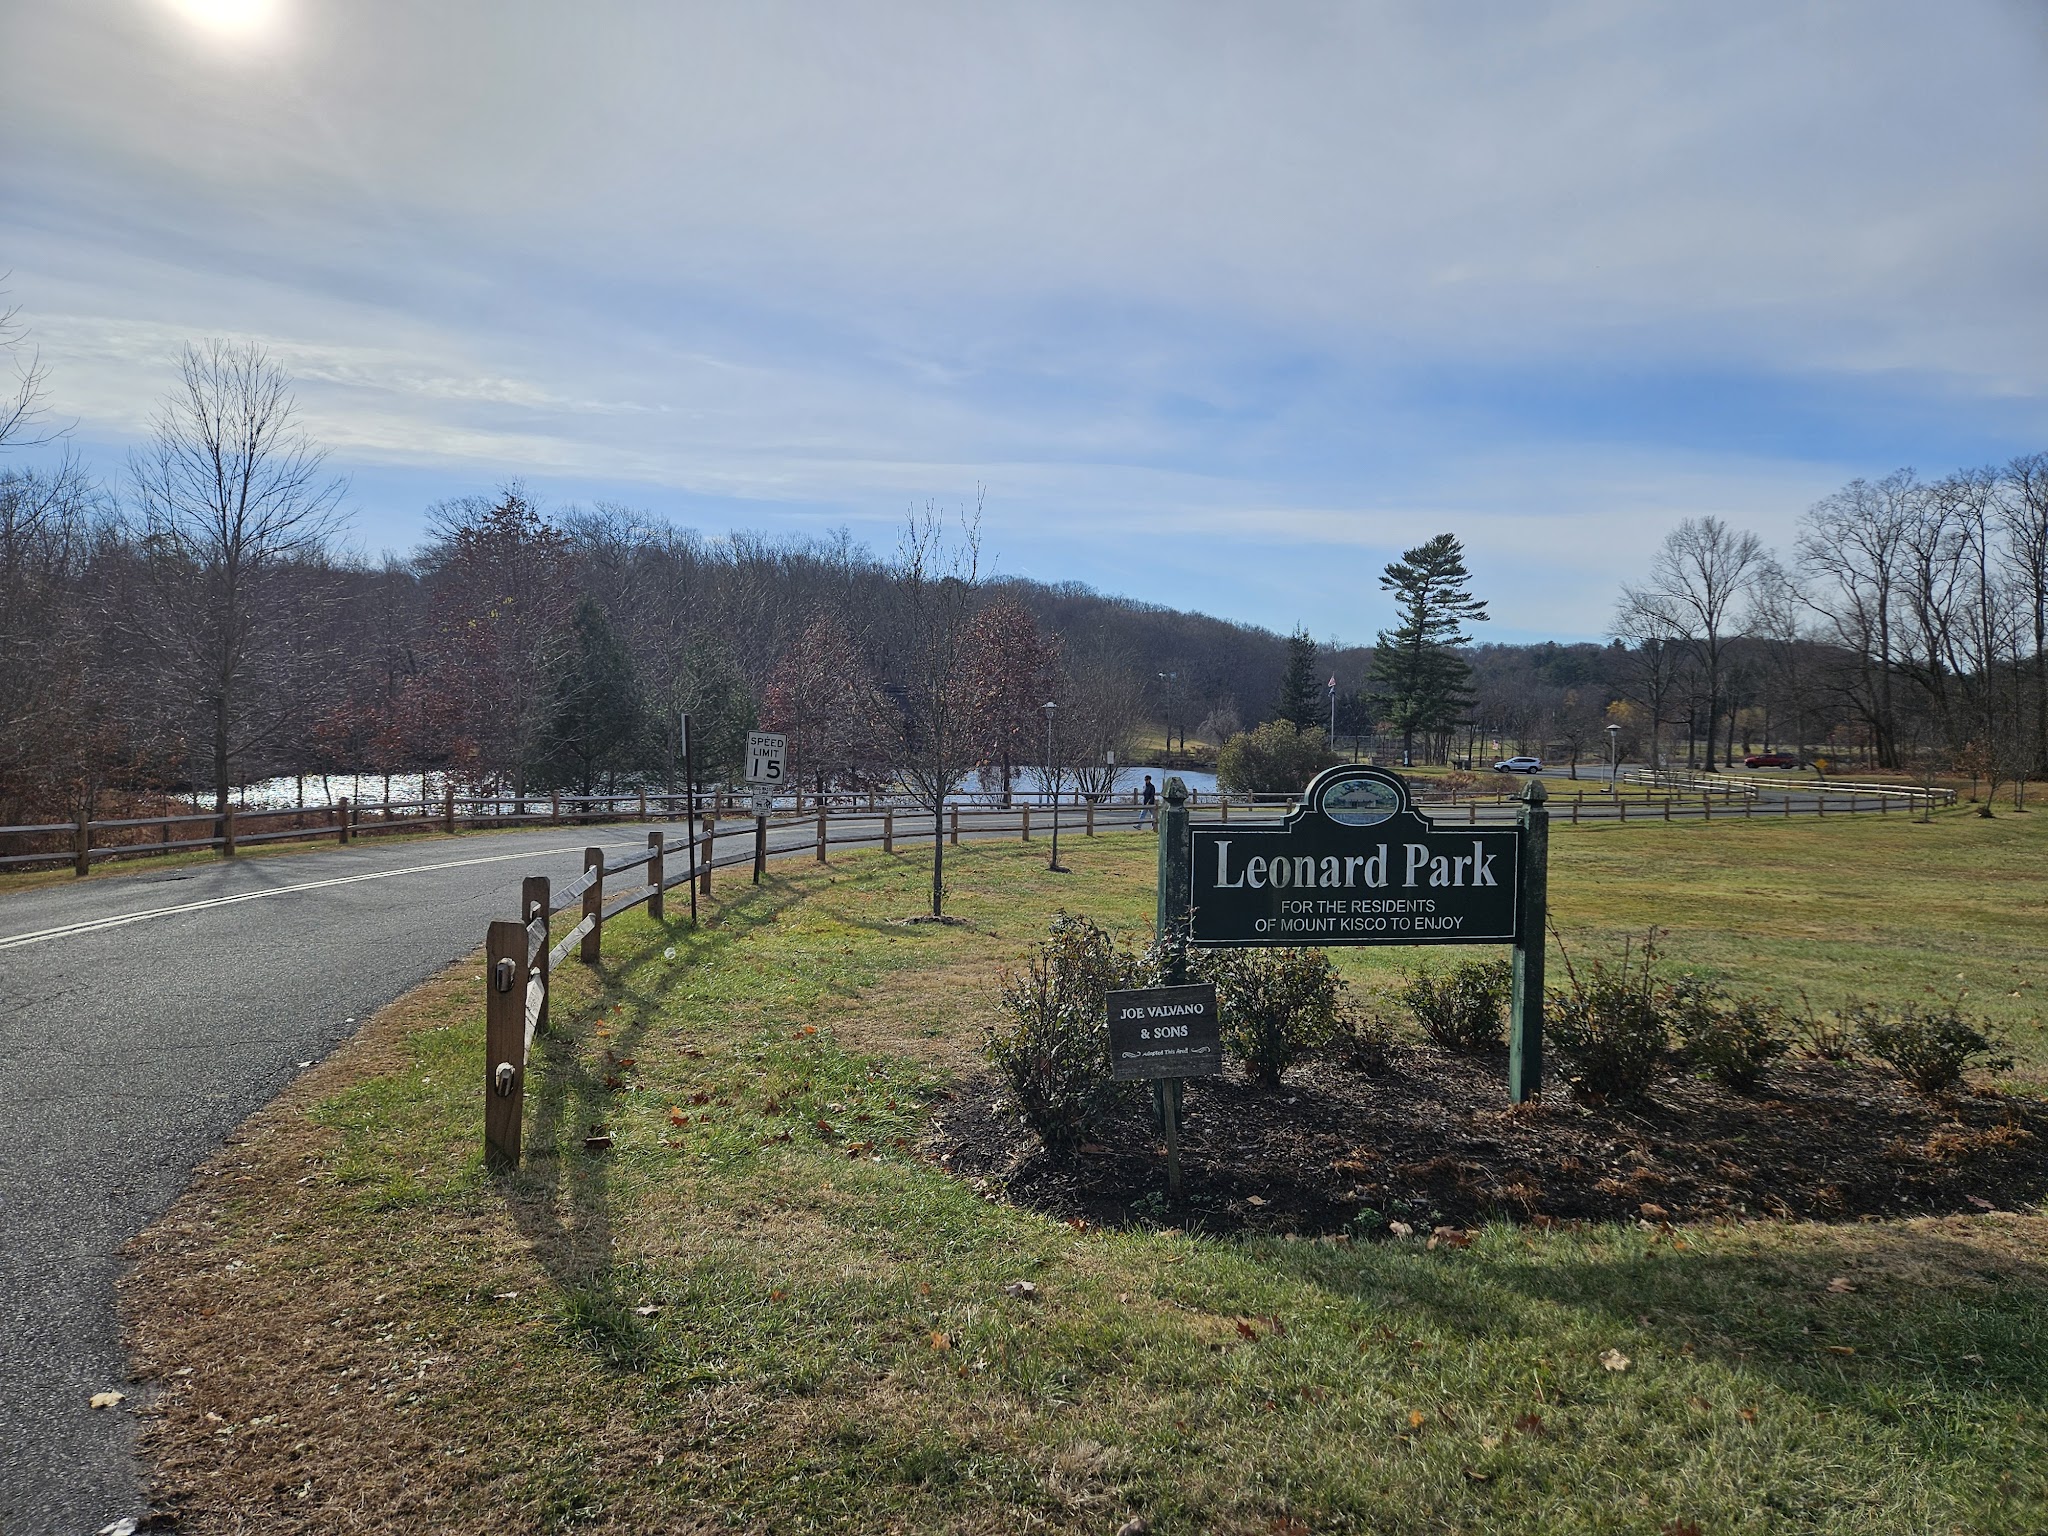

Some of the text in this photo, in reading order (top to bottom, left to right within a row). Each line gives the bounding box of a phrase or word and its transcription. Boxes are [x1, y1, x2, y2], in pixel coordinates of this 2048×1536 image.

[750, 737, 784, 748] SPEED
[753, 748, 779, 758] LIMIT
[753, 758, 781, 779] 15
[1213, 840, 1499, 889] Leonard Park
[1281, 899, 1436, 914] FOR THE RESIDENTS
[1255, 916, 1464, 932] OF MOUNT KISCO TO ENJOY
[1120, 1003, 1204, 1020] JOE VALVANO
[1140, 1025, 1188, 1039] & SONS
